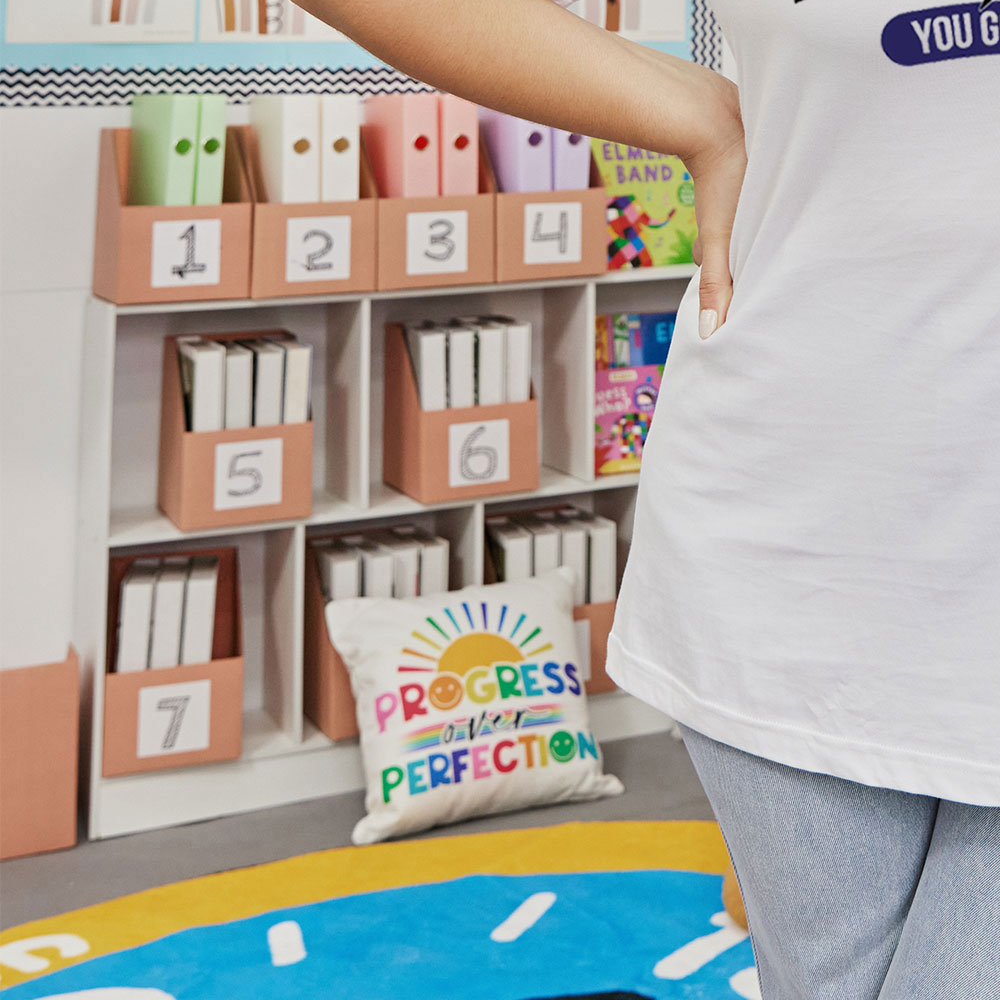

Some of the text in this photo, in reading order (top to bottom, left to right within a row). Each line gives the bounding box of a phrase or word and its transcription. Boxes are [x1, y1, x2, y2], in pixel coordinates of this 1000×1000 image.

[911, 11, 973, 55] YOU
[616, 165, 673, 184] BAND
[171, 224, 207, 279] 1
[302, 229, 334, 271] 2
[424, 219, 456, 261] 3
[531, 211, 568, 254] 4
[226, 450, 264, 497] 5
[459, 426, 499, 480] 6
[375, 661, 582, 734] PROGRESS
[156, 694, 192, 750] 7
[441, 709, 527, 744] over
[381, 729, 599, 804] PERFECTION
